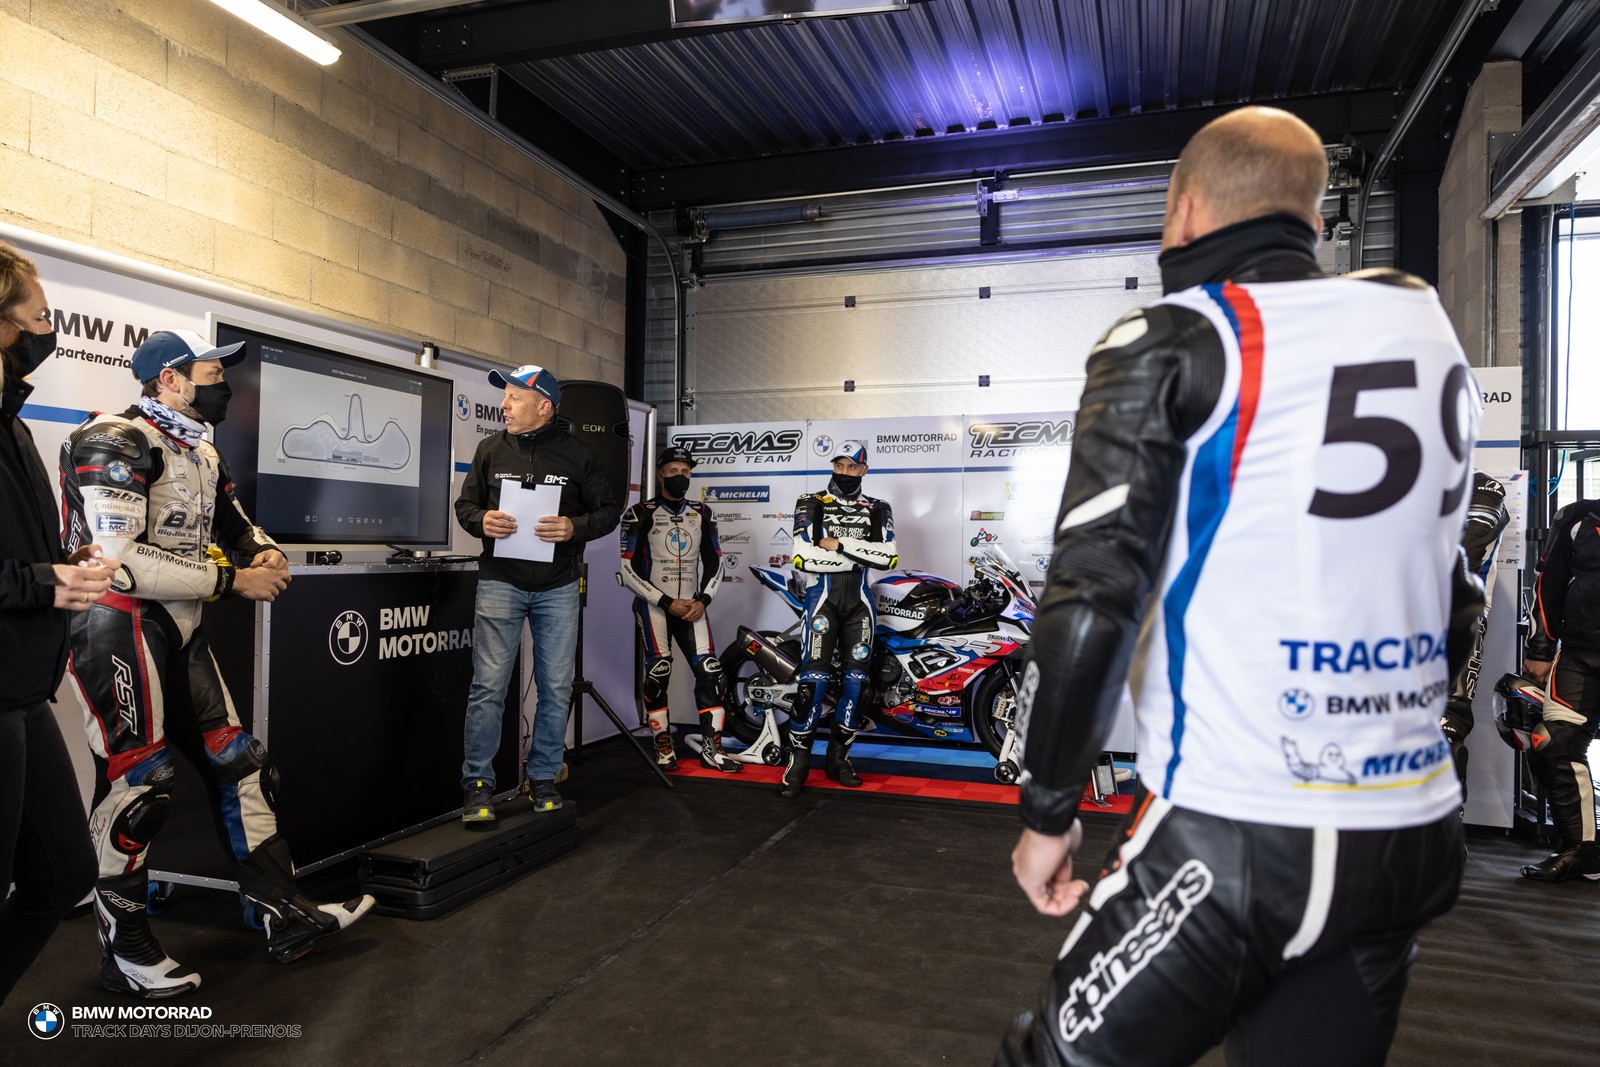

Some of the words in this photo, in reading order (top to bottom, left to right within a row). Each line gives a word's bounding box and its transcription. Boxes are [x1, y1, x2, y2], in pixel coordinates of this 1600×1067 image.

[56, 346, 132, 369] partenaria
[1481, 391, 1512, 403] RAD
[582, 424, 605, 433] EON
[876, 435, 900, 444] BMW
[901, 433, 957, 443] MOTORRAD
[969, 421, 1075, 448] TECM
[1307, 359, 1482, 520] 59
[672, 430, 803, 455] TECMAS
[876, 444, 941, 454] MOTORSPORT
[697, 456, 737, 465] CING
[745, 455, 792, 464] TEAM
[543, 474, 569, 485] BMC
[719, 491, 769, 499] MICHELIN
[762, 512, 795, 522] sens4spee
[136, 546, 165, 561] BMW
[164, 553, 208, 572] Motorrad
[879, 595, 900, 606] BMW
[379, 605, 430, 631] BMW
[878, 605, 925, 620] MOTORRAD
[378, 628, 476, 660] MOTORRA
[112, 654, 138, 736] RST
[1326, 693, 1391, 715] BMW
[1361, 740, 1448, 777] MICHE
[100, 890, 146, 913] RST
